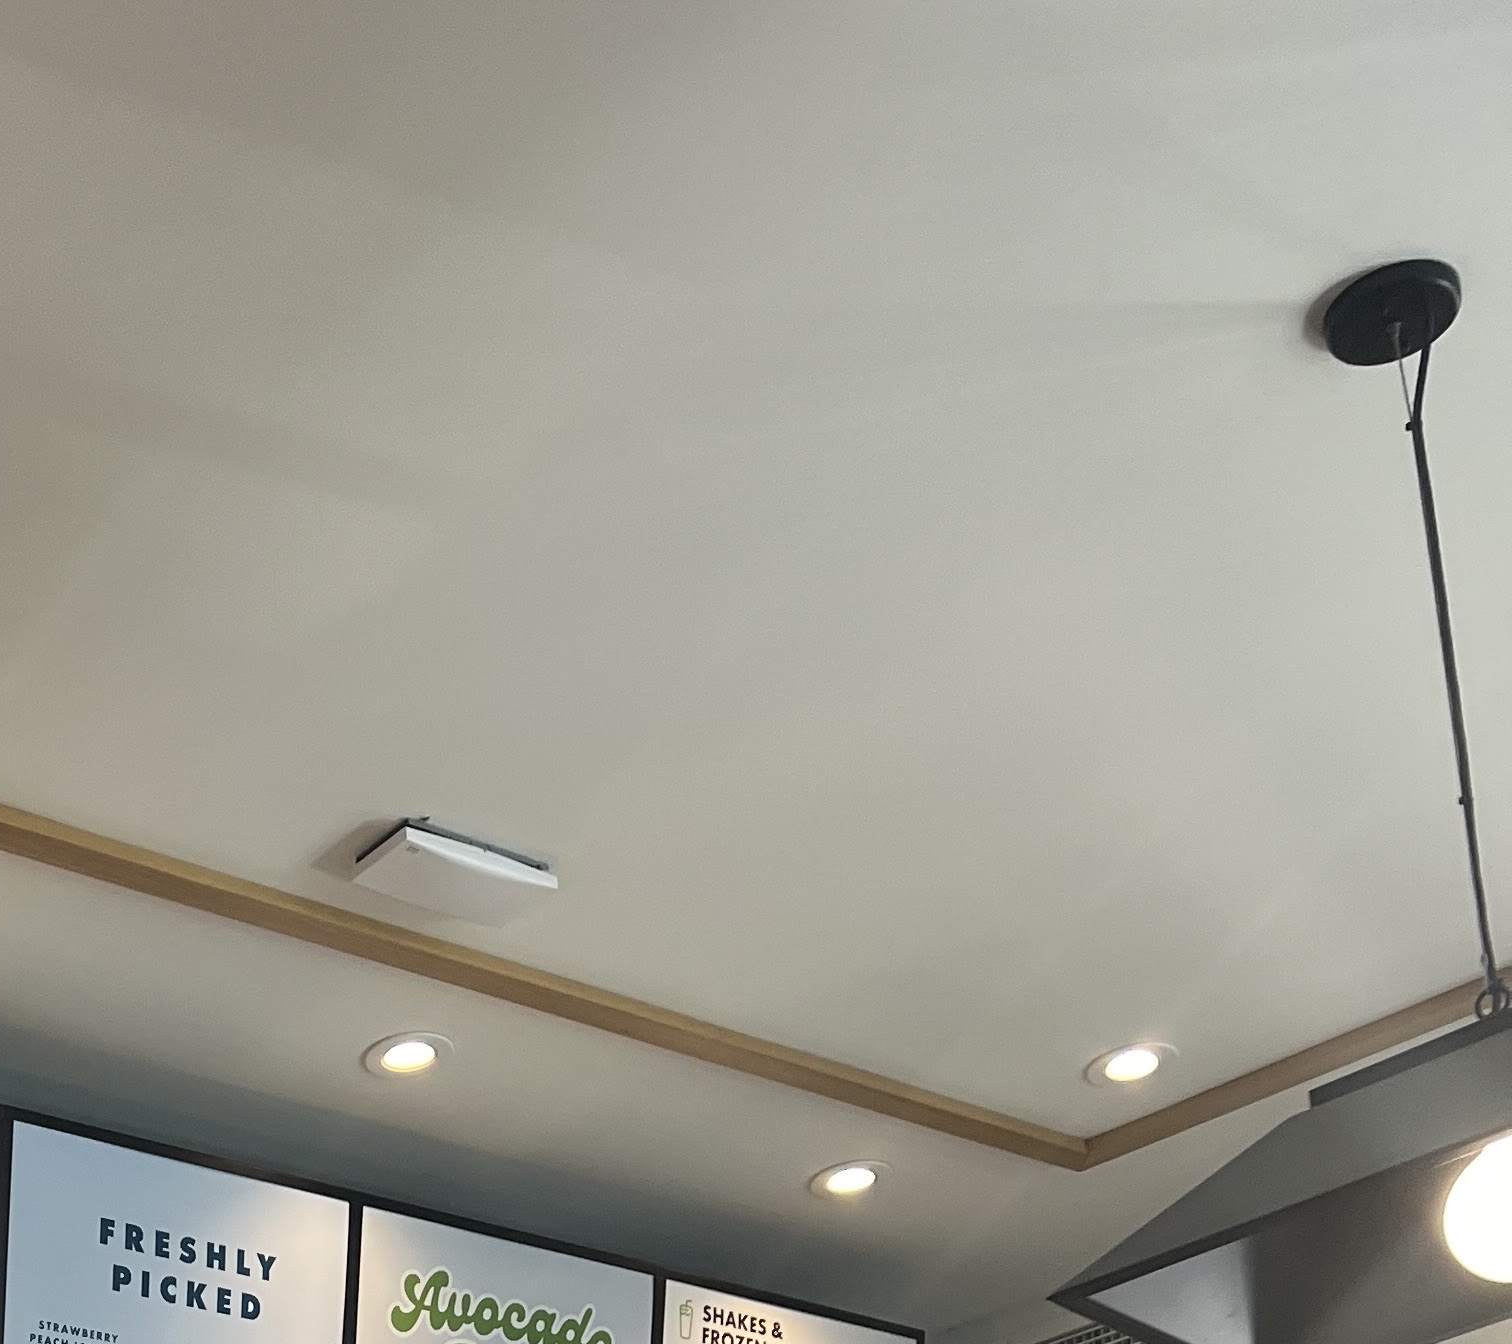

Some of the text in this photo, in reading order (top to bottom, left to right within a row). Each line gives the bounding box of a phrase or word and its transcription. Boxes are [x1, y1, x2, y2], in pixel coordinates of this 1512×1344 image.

[99, 1216, 277, 1281] FRESHLY
[111, 1263, 260, 1320] PICKED
[38, 1319, 118, 1343] STRAWBERRY
[702, 1304, 783, 1340] SHAKES &
